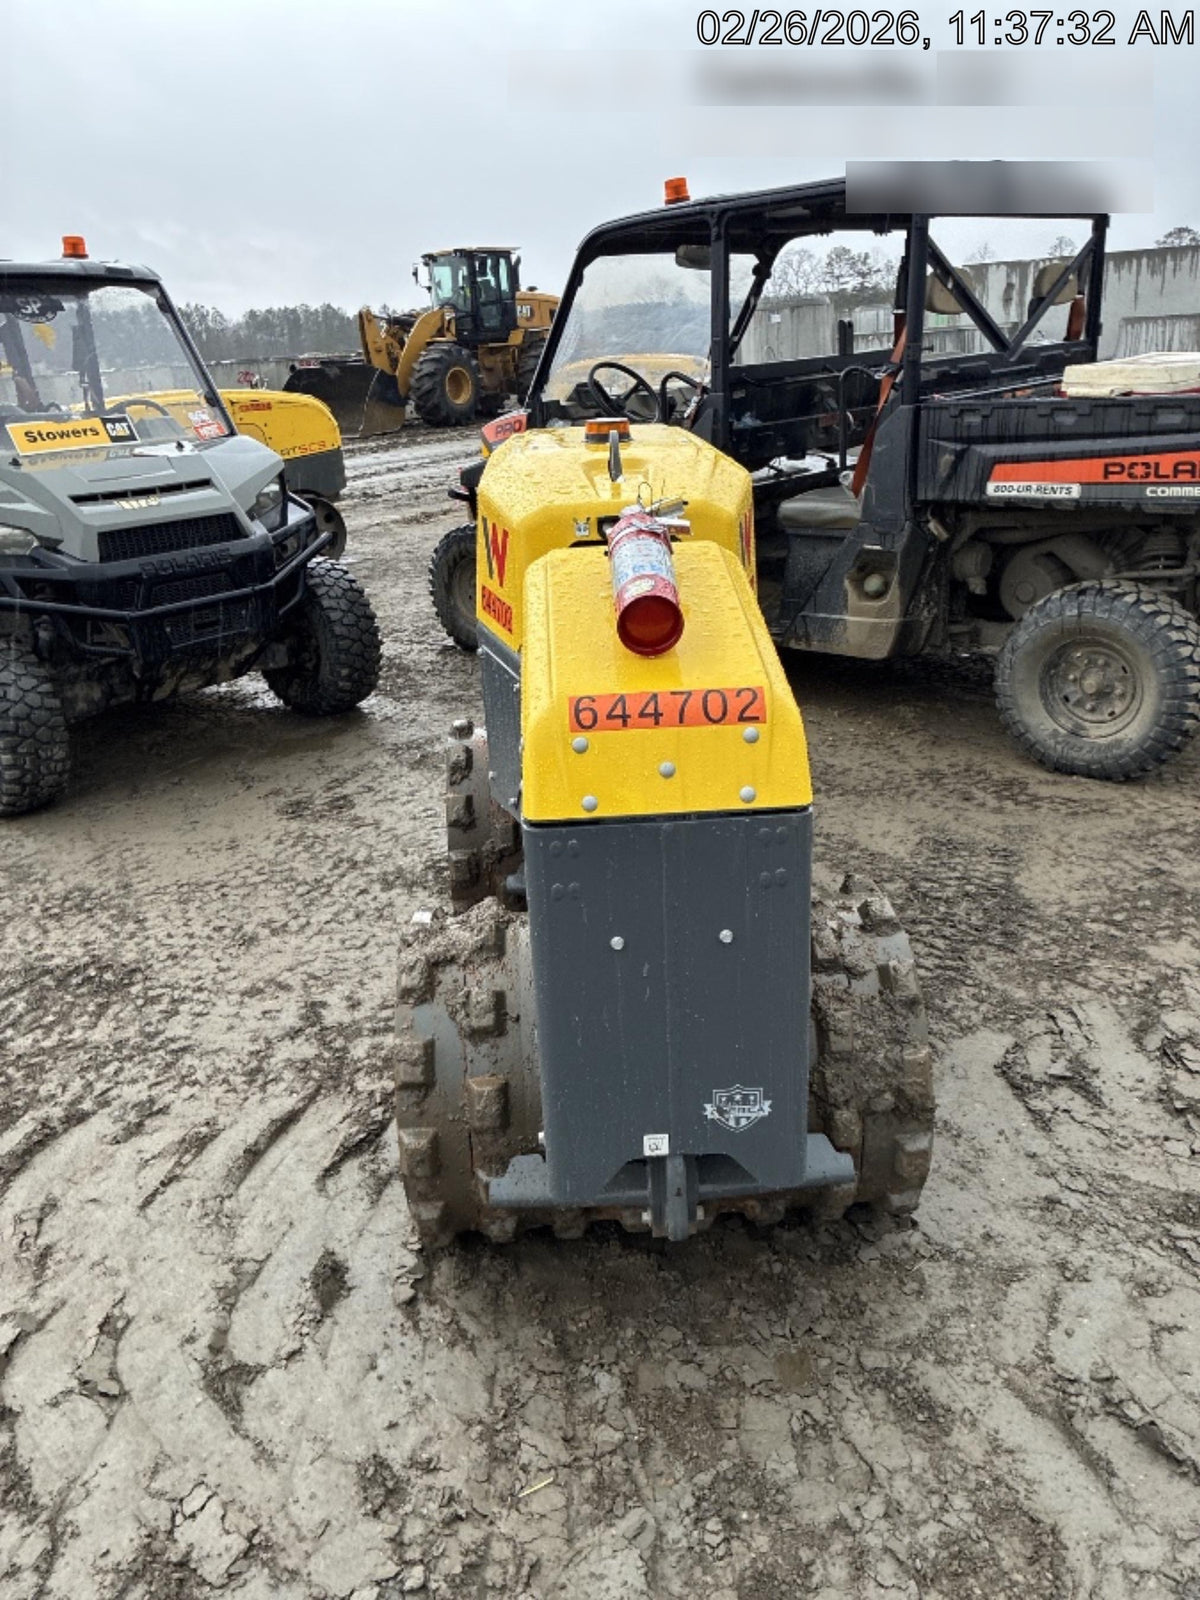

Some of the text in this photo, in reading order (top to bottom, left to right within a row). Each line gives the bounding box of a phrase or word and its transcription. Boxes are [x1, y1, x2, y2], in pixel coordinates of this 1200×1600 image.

[24, 419, 131, 443] Stowers CAT
[493, 418, 523, 439] PRO
[1103, 460, 1200, 480] POLA
[138, 547, 232, 579] POLARIS
[573, 687, 762, 730] 644702
